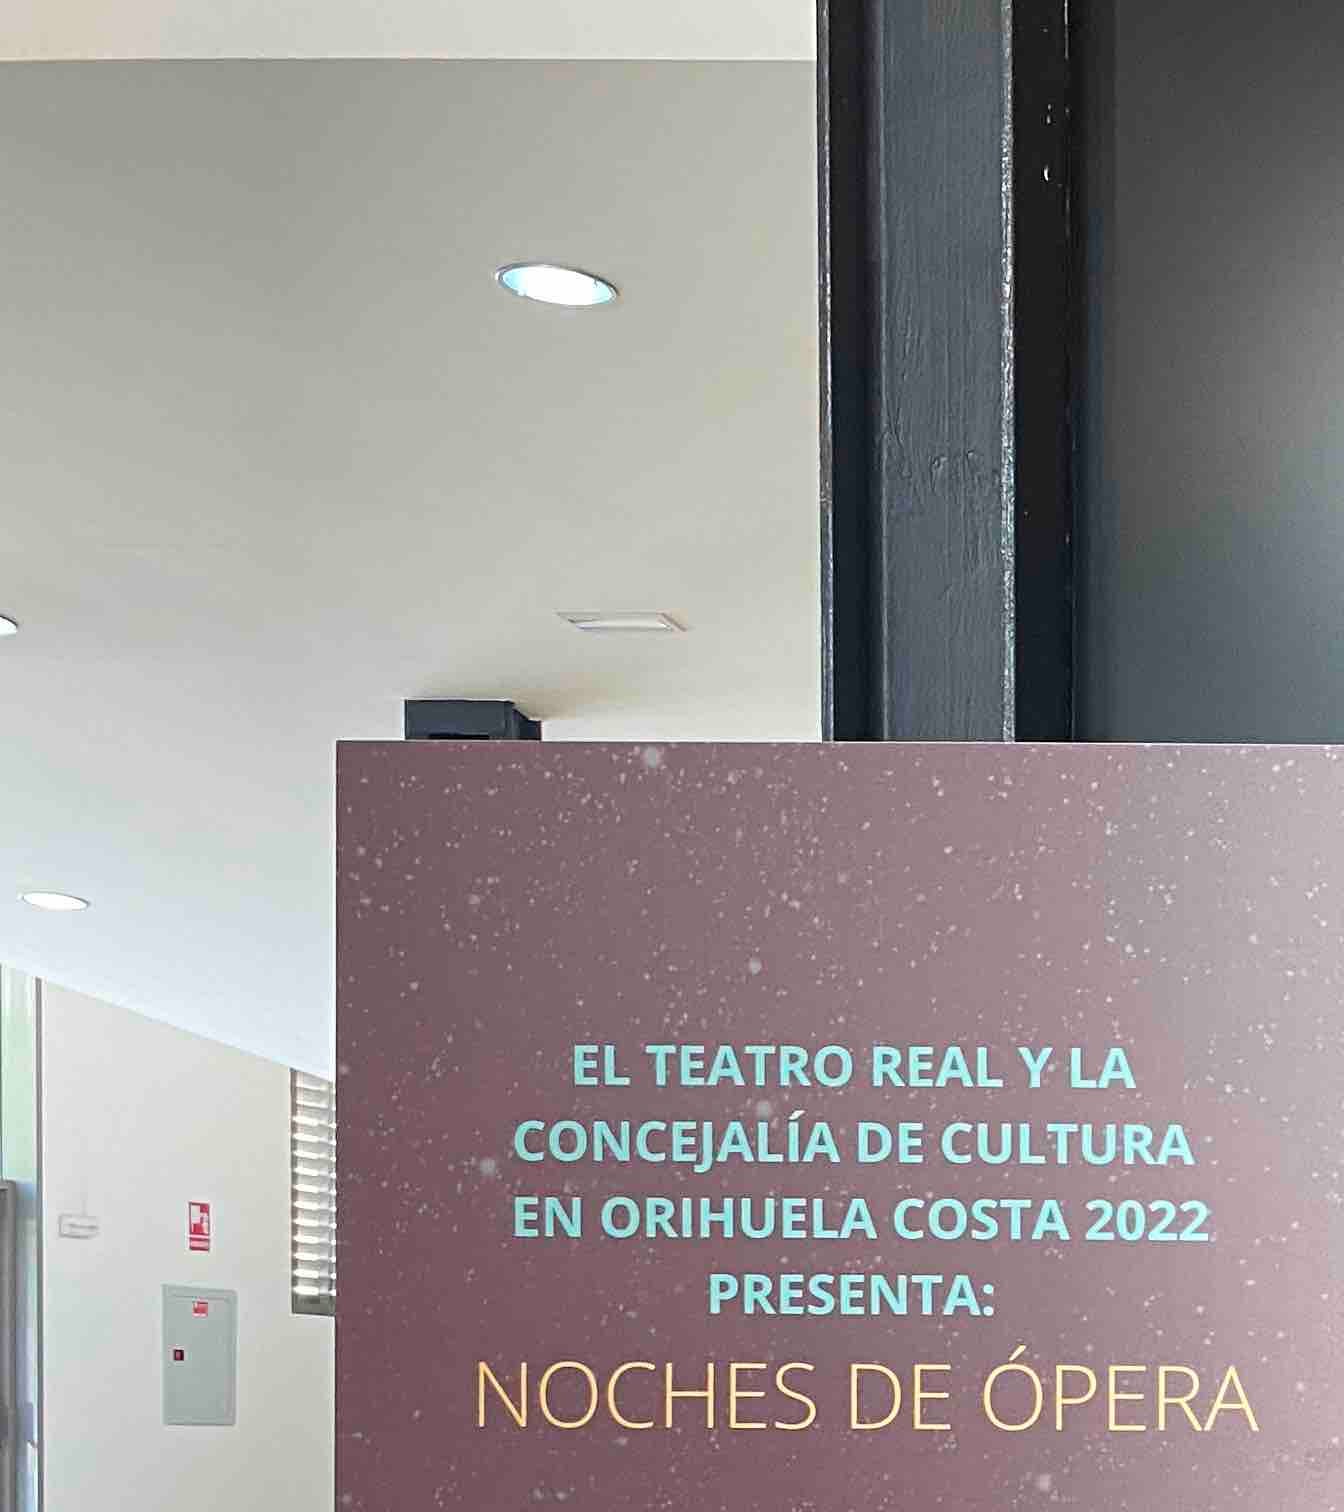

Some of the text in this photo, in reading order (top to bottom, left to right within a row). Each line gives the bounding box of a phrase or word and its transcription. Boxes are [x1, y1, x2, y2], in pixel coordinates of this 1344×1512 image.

[572, 1042, 1136, 1090] EL TEATRO REAL Y LA
[513, 1110, 1196, 1175] CONCEJALÍA DE CULTURA
[511, 1197, 1210, 1243] EN ORIHUELA COSTA 2022
[708, 1272, 996, 1315] PRESENTA:
[475, 1343, 1257, 1435] NOCHES DE ÓPERA
